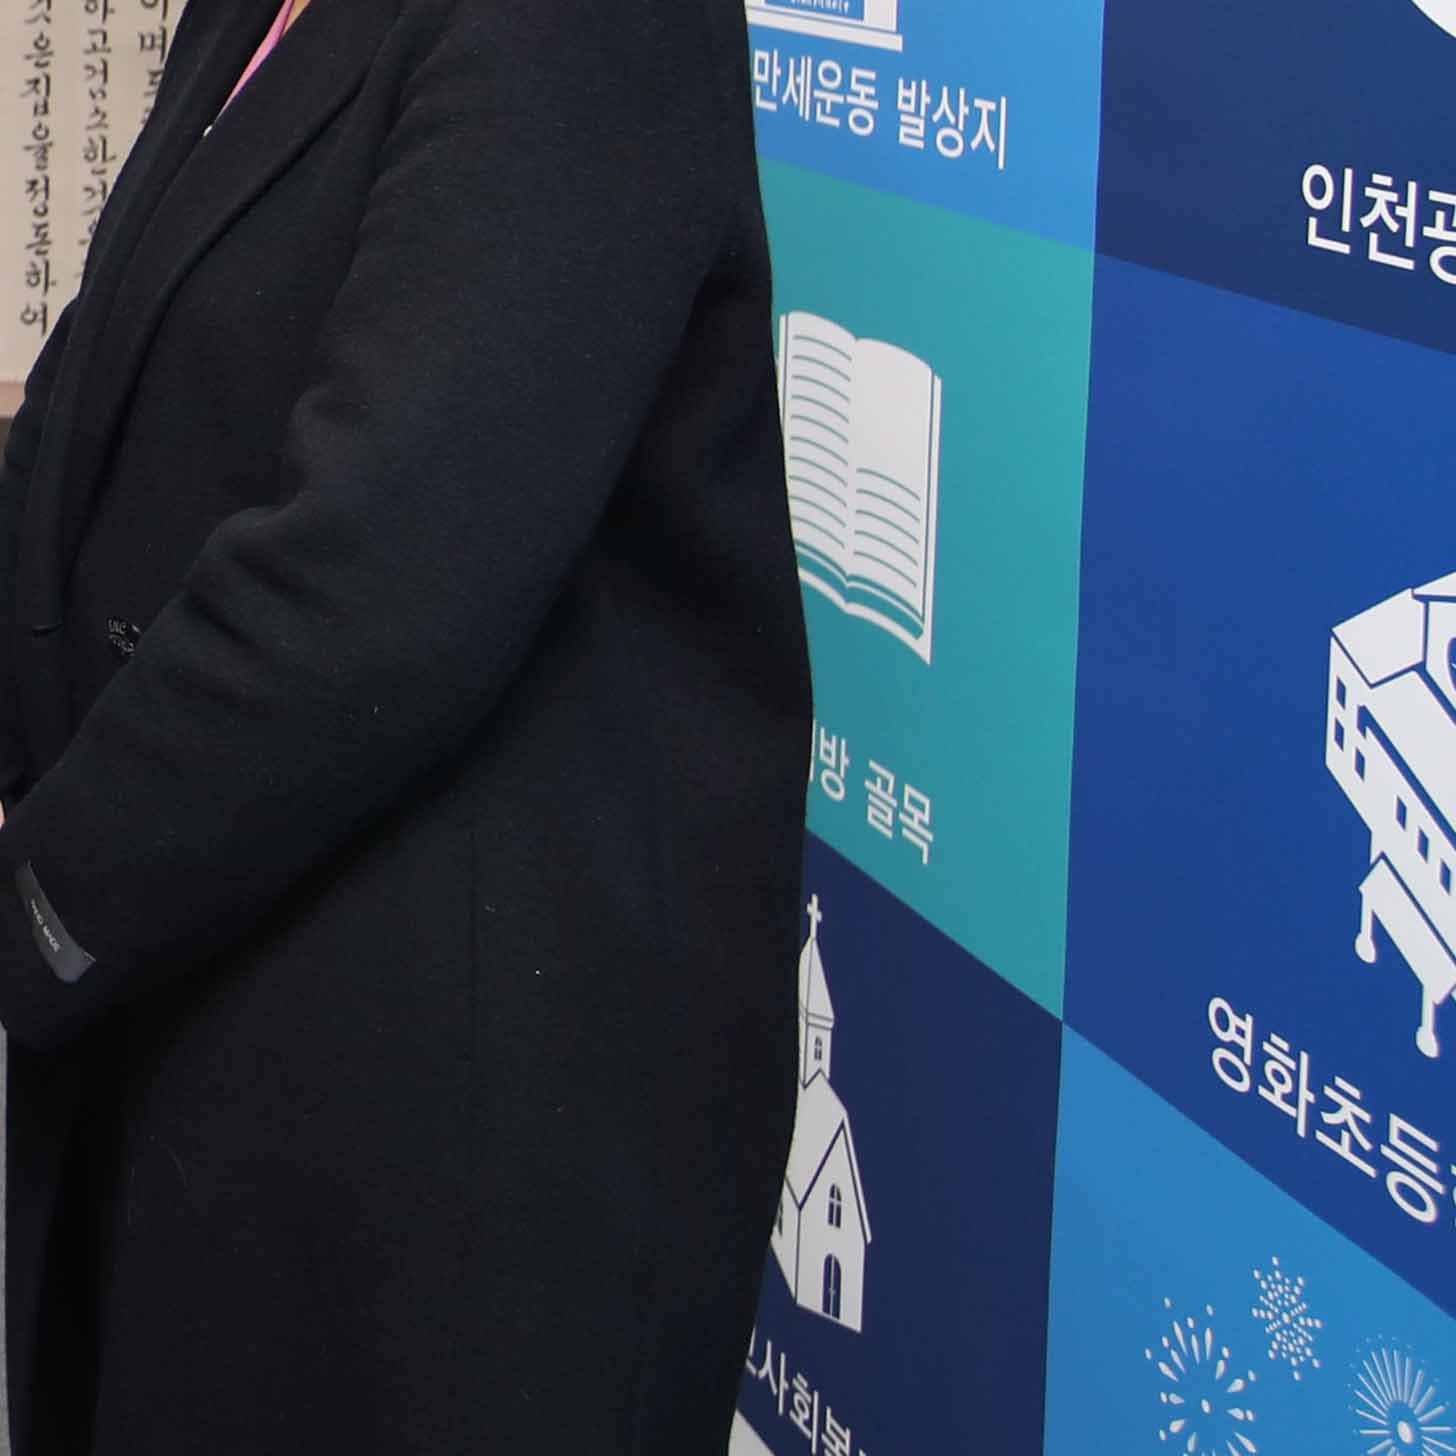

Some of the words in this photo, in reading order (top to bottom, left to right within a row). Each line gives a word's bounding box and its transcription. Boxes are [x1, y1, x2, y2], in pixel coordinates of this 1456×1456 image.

[752, 46, 880, 137] 만세운동
[896, 74, 1007, 170] 발상지
[810, 718, 850, 801] 방
[864, 759, 934, 865] 골목
[1207, 997, 1456, 1224] 영화초등
[746, 1327, 867, 1456] 사회복
